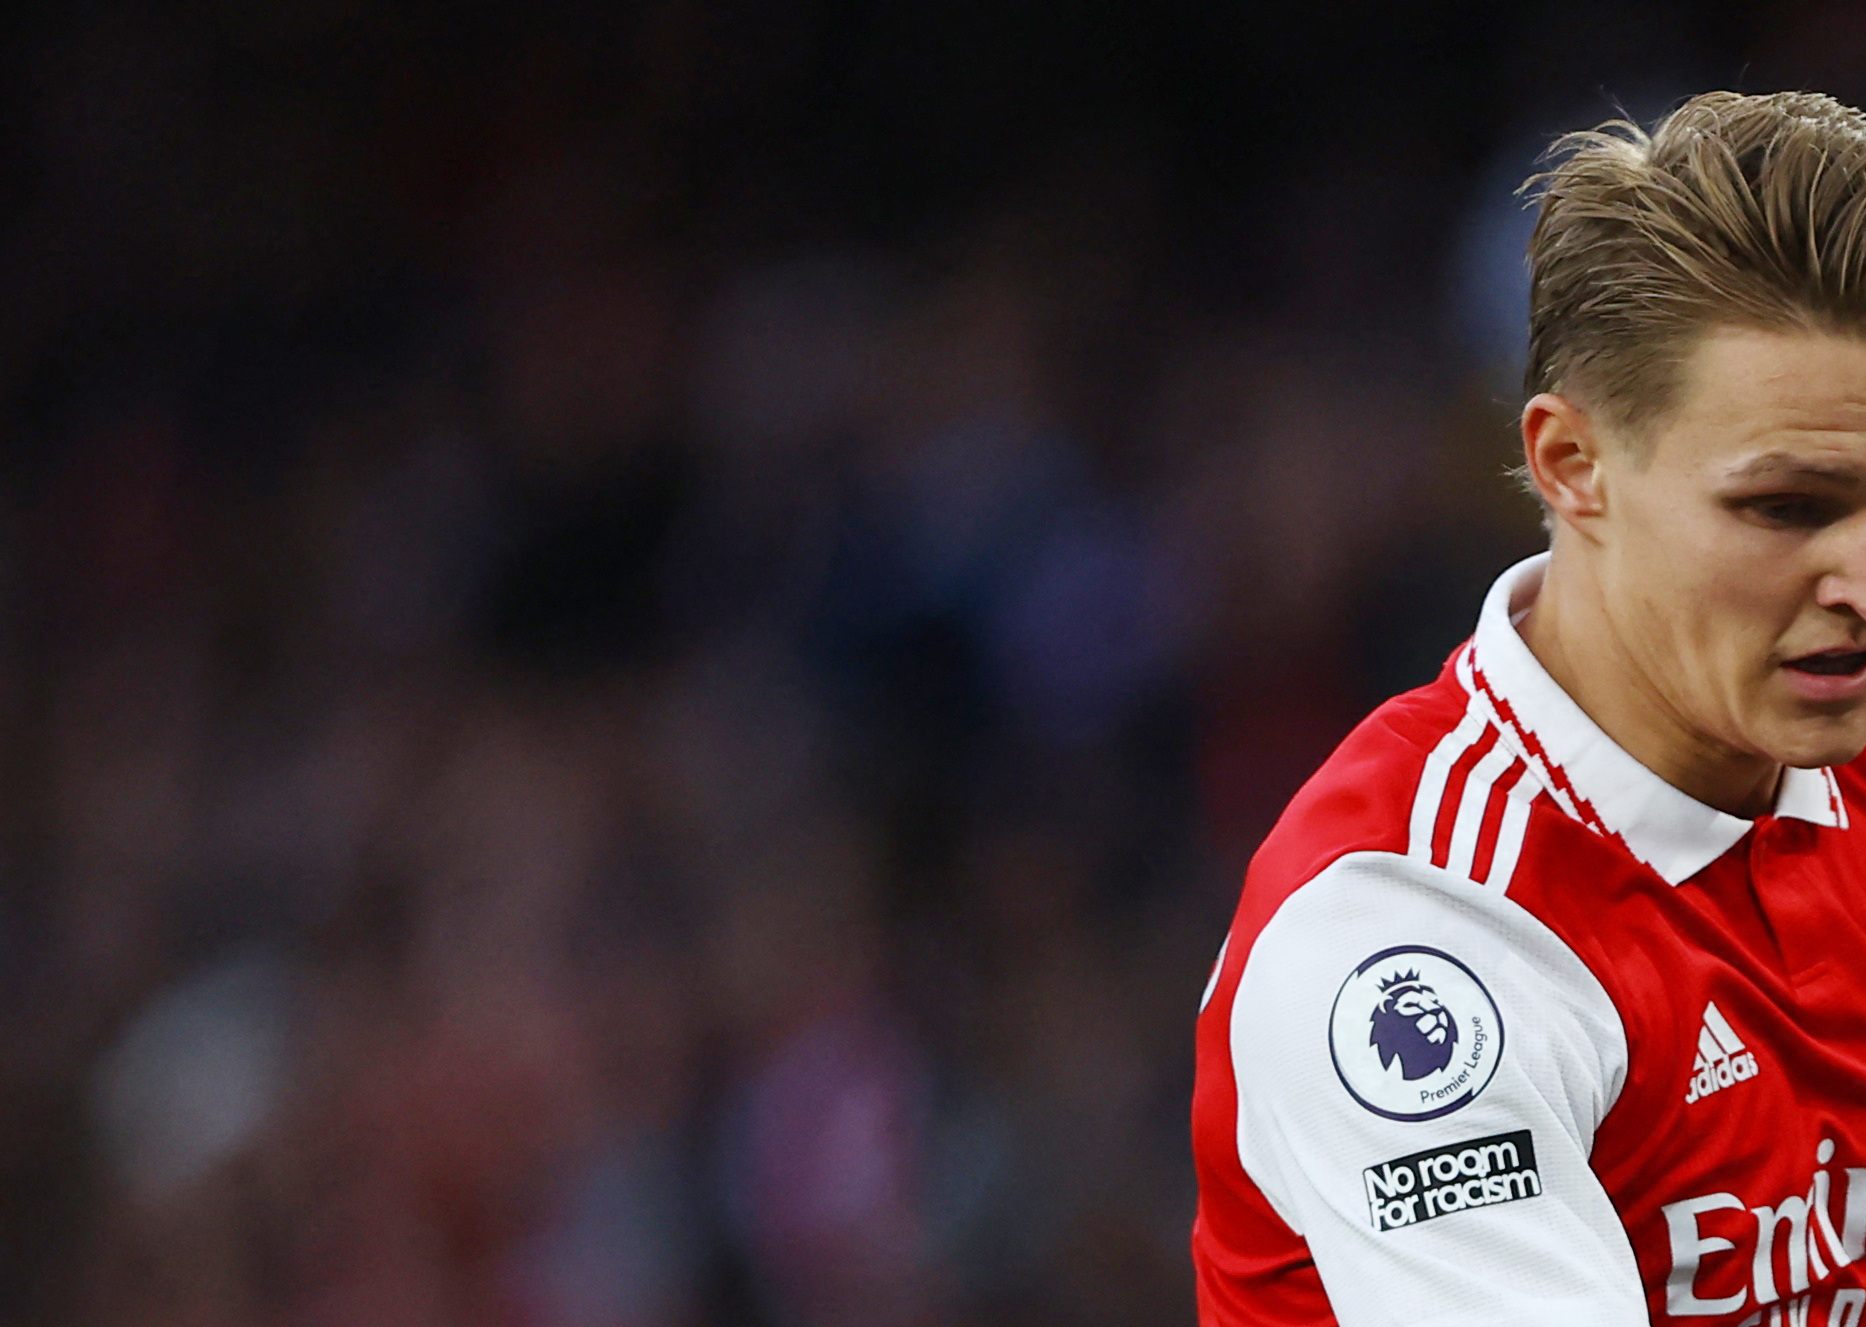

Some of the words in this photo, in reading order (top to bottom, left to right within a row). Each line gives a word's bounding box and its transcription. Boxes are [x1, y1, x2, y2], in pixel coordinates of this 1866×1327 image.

[1420, 1068, 1470, 1104] Premier
[1464, 1015, 1488, 1069] League
[1685, 1051, 1759, 1104] adidas
[1364, 1164, 1416, 1199] No
[1418, 1141, 1520, 1185] room
[1371, 1198, 1418, 1231] for
[1424, 1169, 1541, 1216] racism
